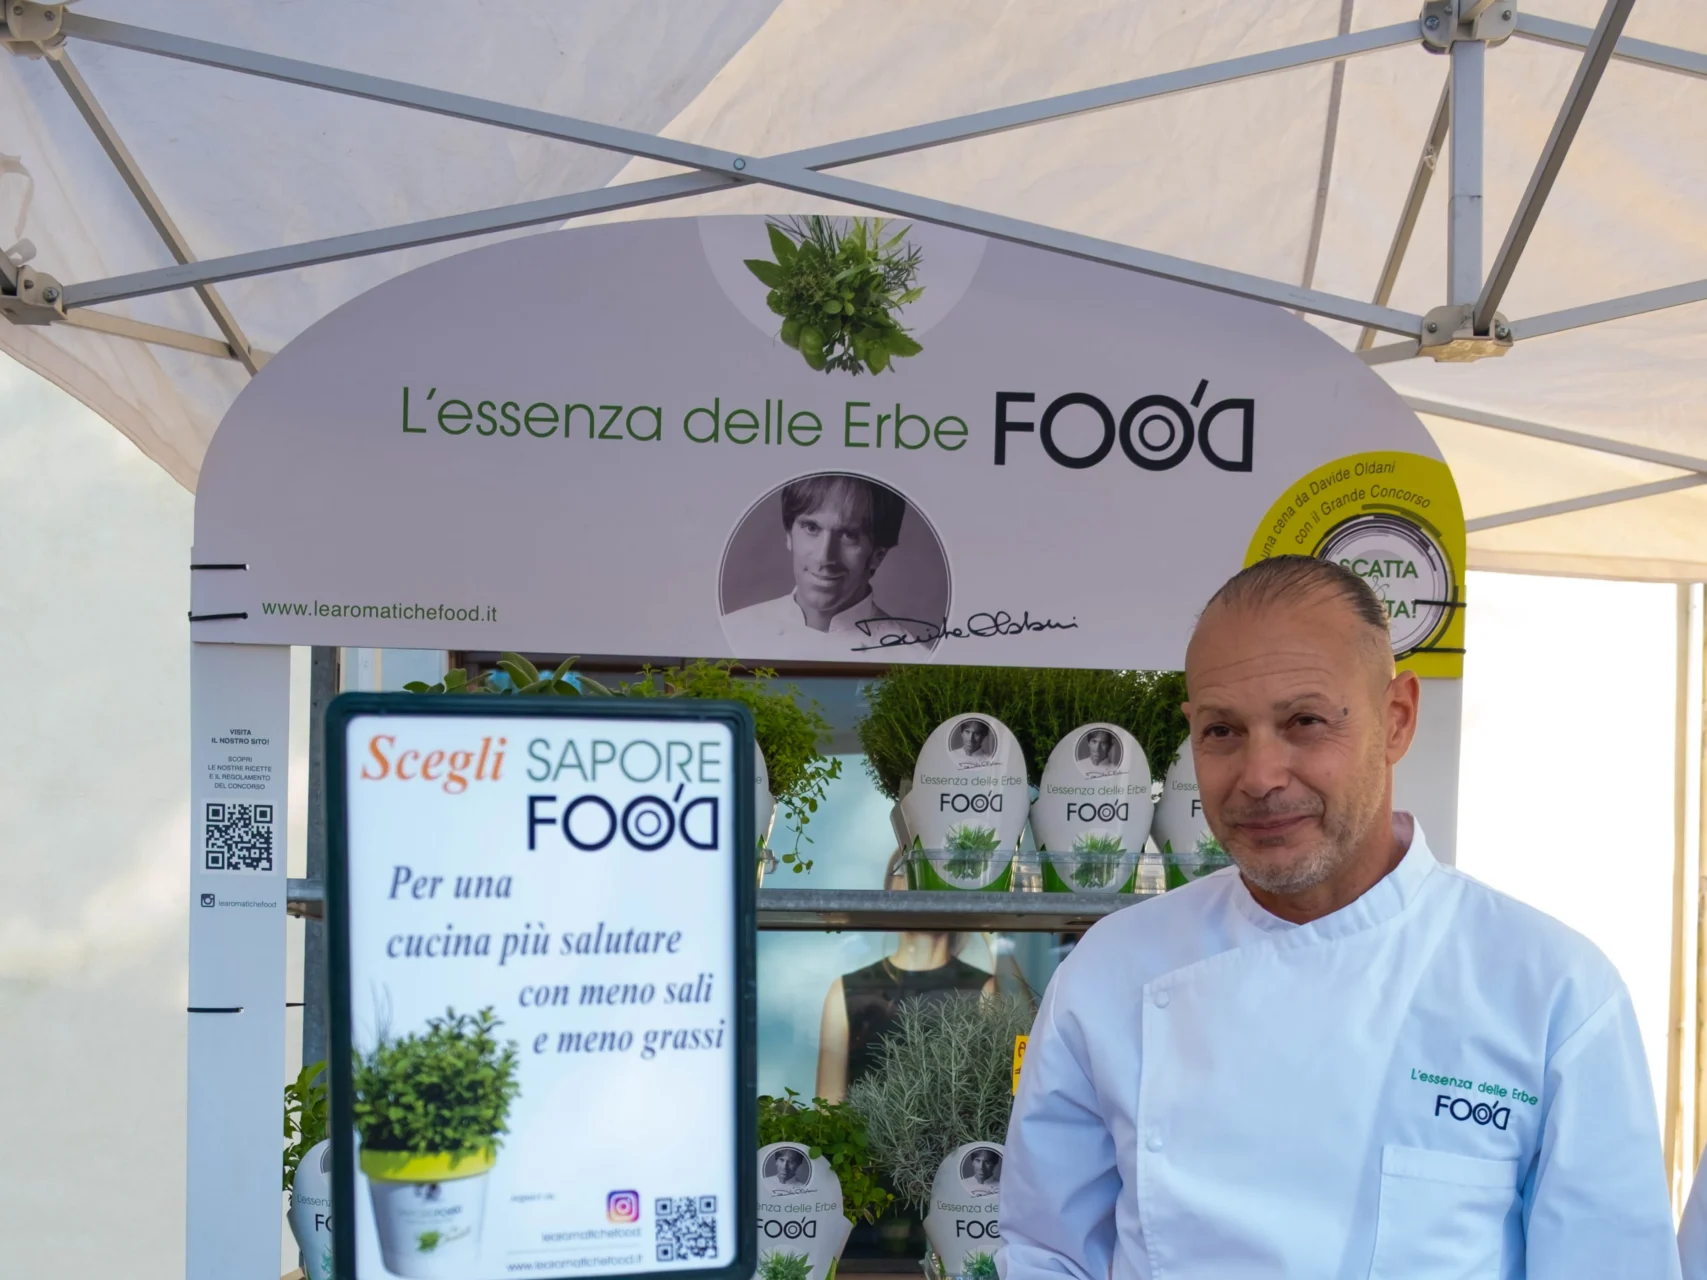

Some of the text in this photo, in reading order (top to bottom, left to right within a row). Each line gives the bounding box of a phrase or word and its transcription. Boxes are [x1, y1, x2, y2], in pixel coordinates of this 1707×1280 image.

[402, 386, 662, 441] L'essenza
[683, 398, 823, 446] delle
[844, 402, 969, 451] Erbe
[1260, 460, 1397, 559] una cena da Davide Oldani
[1295, 484, 1432, 545] con il Grande Concorso
[261, 599, 498, 623] www.learomatichefood.it
[216, 764, 244, 772] NOSTRE
[244, 765, 272, 773] RICETTE
[221, 774, 271, 782] REGOLAMENTO
[360, 734, 722, 795] Scegli SAPORE
[920, 773, 1023, 787] L'essenza delle Erbe
[1046, 783, 1148, 797] L'essenza delle Erbe
[388, 865, 513, 900] Per una
[218, 899, 277, 908] learomatichefood
[385, 921, 683, 966] cucina più salutare
[518, 973, 715, 1008] con meno sali
[532, 1018, 726, 1061] e meno grassi
[1410, 1067, 1539, 1106] L'essenza delle Erbe
[784, 1202, 812, 1213] delle
[815, 1202, 837, 1213] Erbe
[936, 1199, 982, 1214] L'essenza
